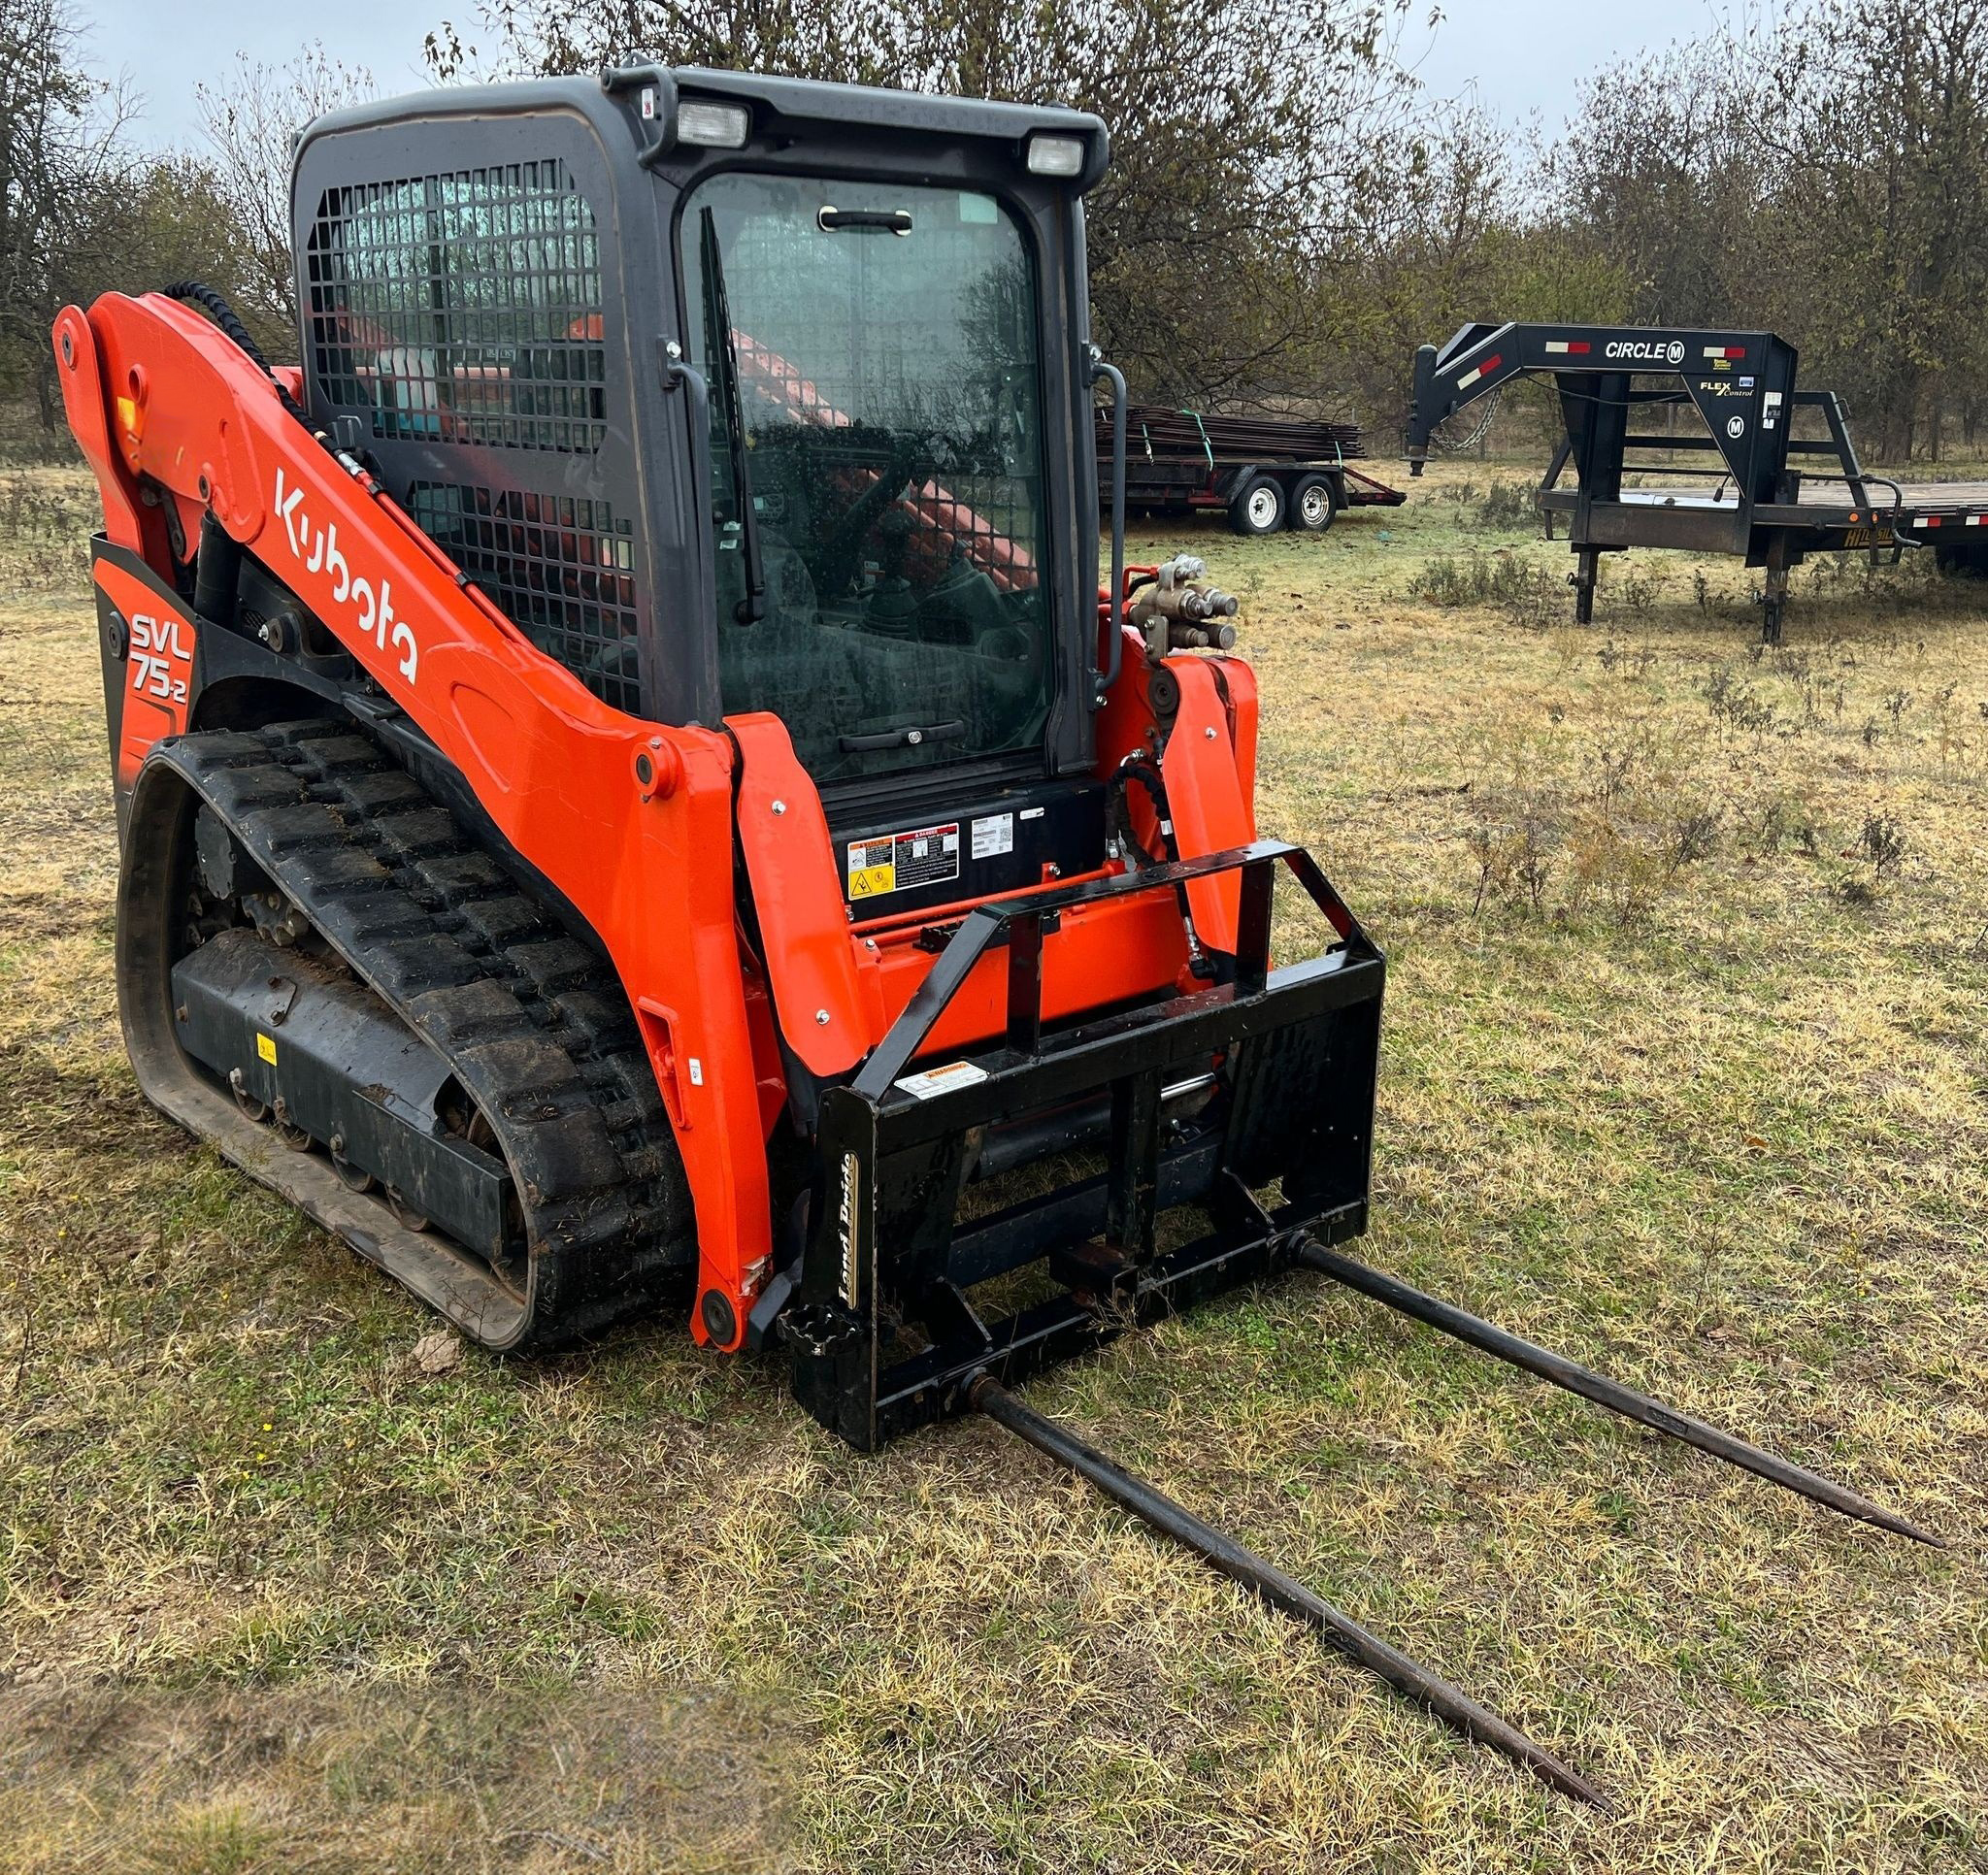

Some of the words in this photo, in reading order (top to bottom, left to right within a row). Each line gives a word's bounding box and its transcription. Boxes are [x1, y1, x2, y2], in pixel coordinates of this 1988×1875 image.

[1606, 342, 1666, 359] CIRCLE
[1701, 382, 1731, 396] FLEX
[274, 467, 417, 685] Kubota
[130, 614, 190, 661] SVL
[130, 652, 186, 704] 75-2
[840, 1153, 852, 1227] Pride
[838, 1228, 852, 1302] Land
